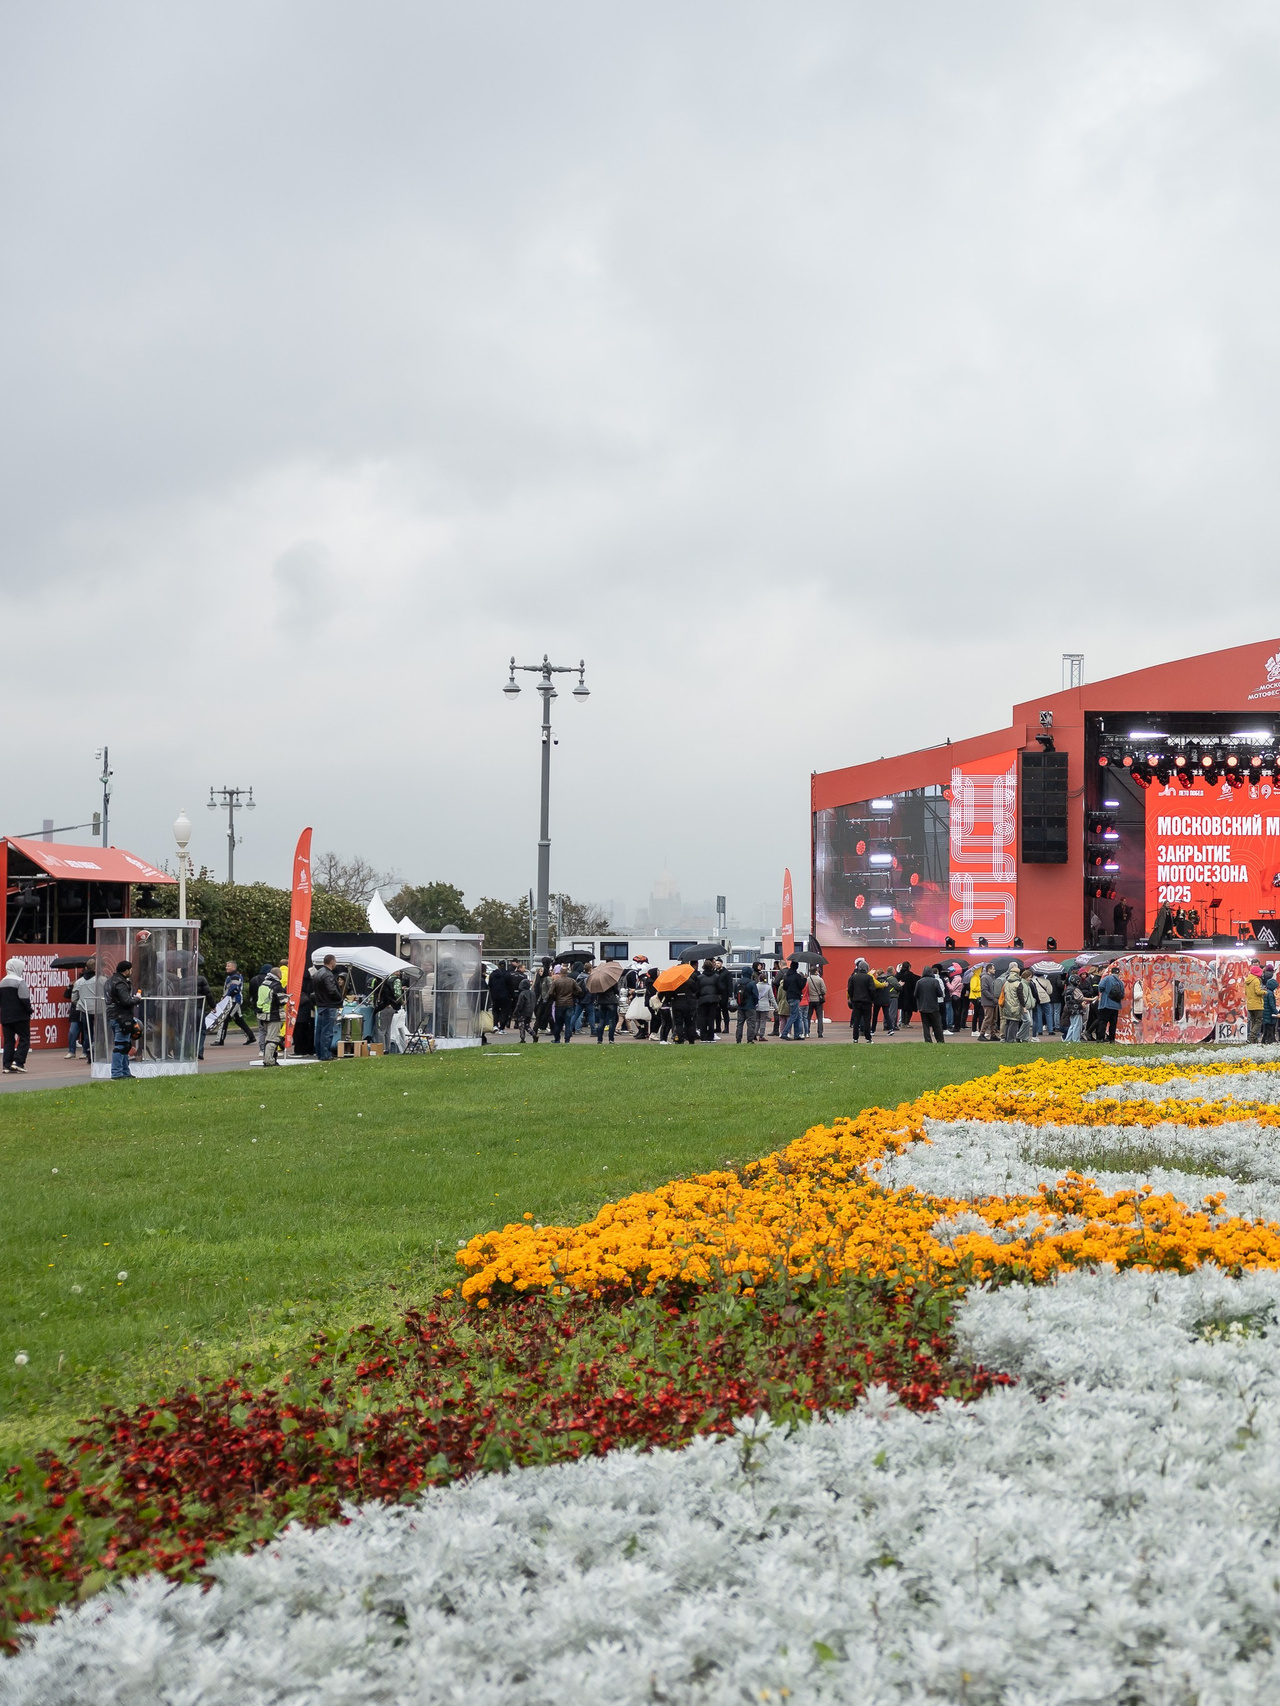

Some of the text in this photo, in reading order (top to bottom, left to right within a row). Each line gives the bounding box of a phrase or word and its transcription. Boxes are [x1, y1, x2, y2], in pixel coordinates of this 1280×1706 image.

[1157, 814, 1262, 836] МОСКОВСКИЙ
[1157, 845, 1231, 863] ЗАКРЫТИЕ
[1157, 865, 1249, 883] МОТОСЕЗОНА
[1158, 885, 1192, 903] 2025
[21, 971, 70, 987] ТОФЕСТИВАЛЬ
[30, 987, 48, 1003] ЫТИЕ
[30, 1003, 56, 1020] СЕЗОНА
